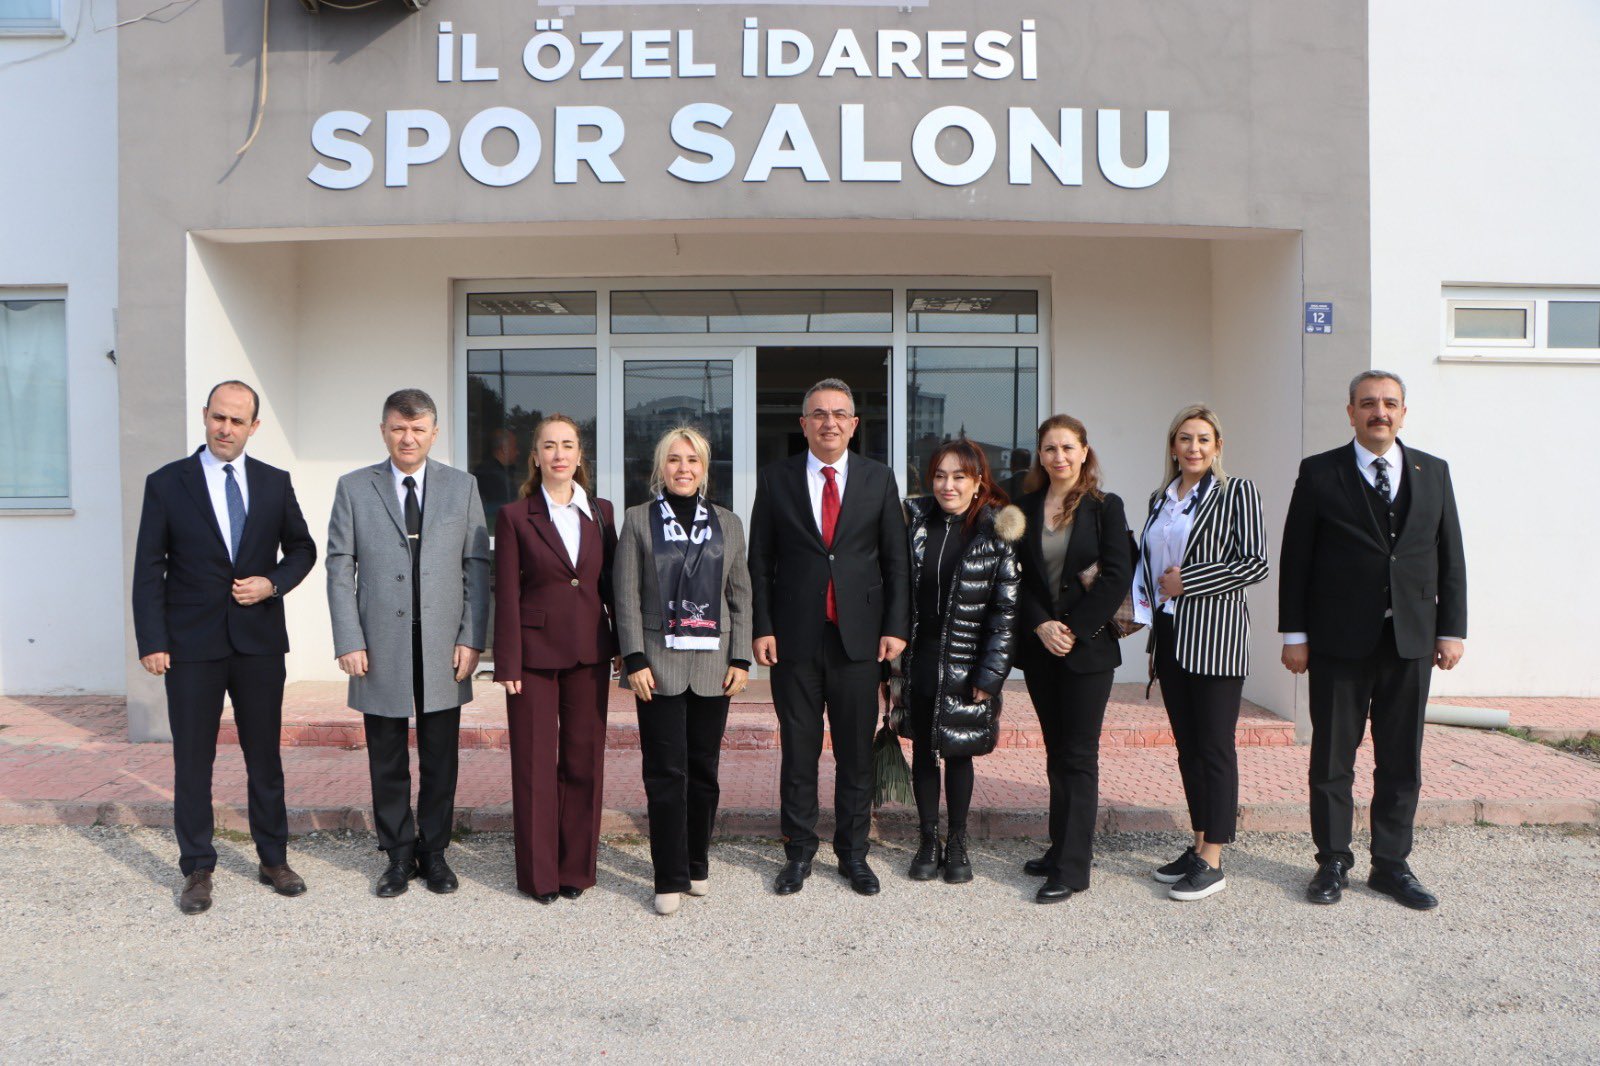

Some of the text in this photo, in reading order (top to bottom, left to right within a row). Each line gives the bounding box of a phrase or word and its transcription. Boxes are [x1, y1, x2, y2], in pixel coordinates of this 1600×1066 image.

[437, 16, 1039, 83] İL ÖZEL İDARESİ
[307, 102, 1171, 190] SPOR SALONU
[1312, 312, 1325, 323] 12
